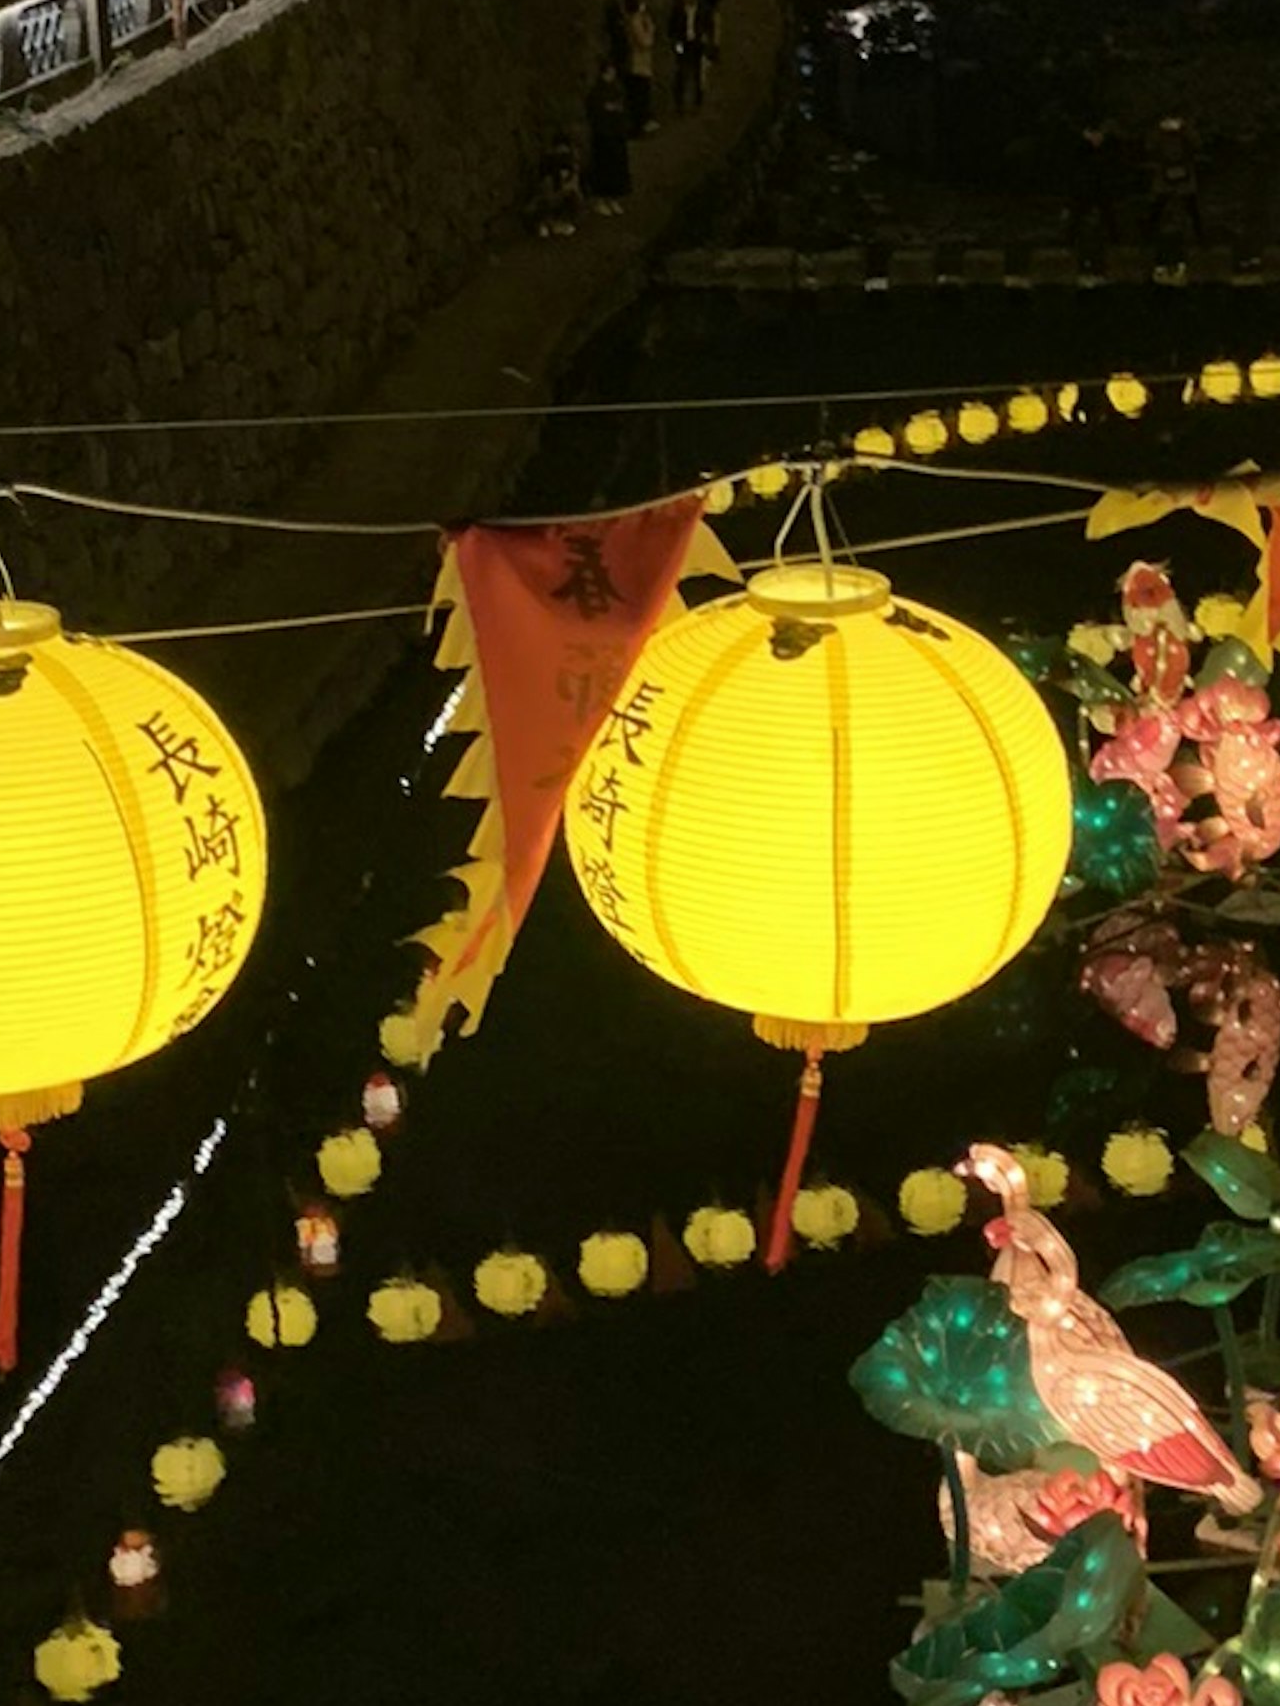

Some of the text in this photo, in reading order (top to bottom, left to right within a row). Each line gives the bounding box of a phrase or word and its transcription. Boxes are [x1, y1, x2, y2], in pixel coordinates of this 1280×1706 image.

[136, 710, 246, 1035] 長崎燈
[578, 680, 664, 964] 長崎燈
